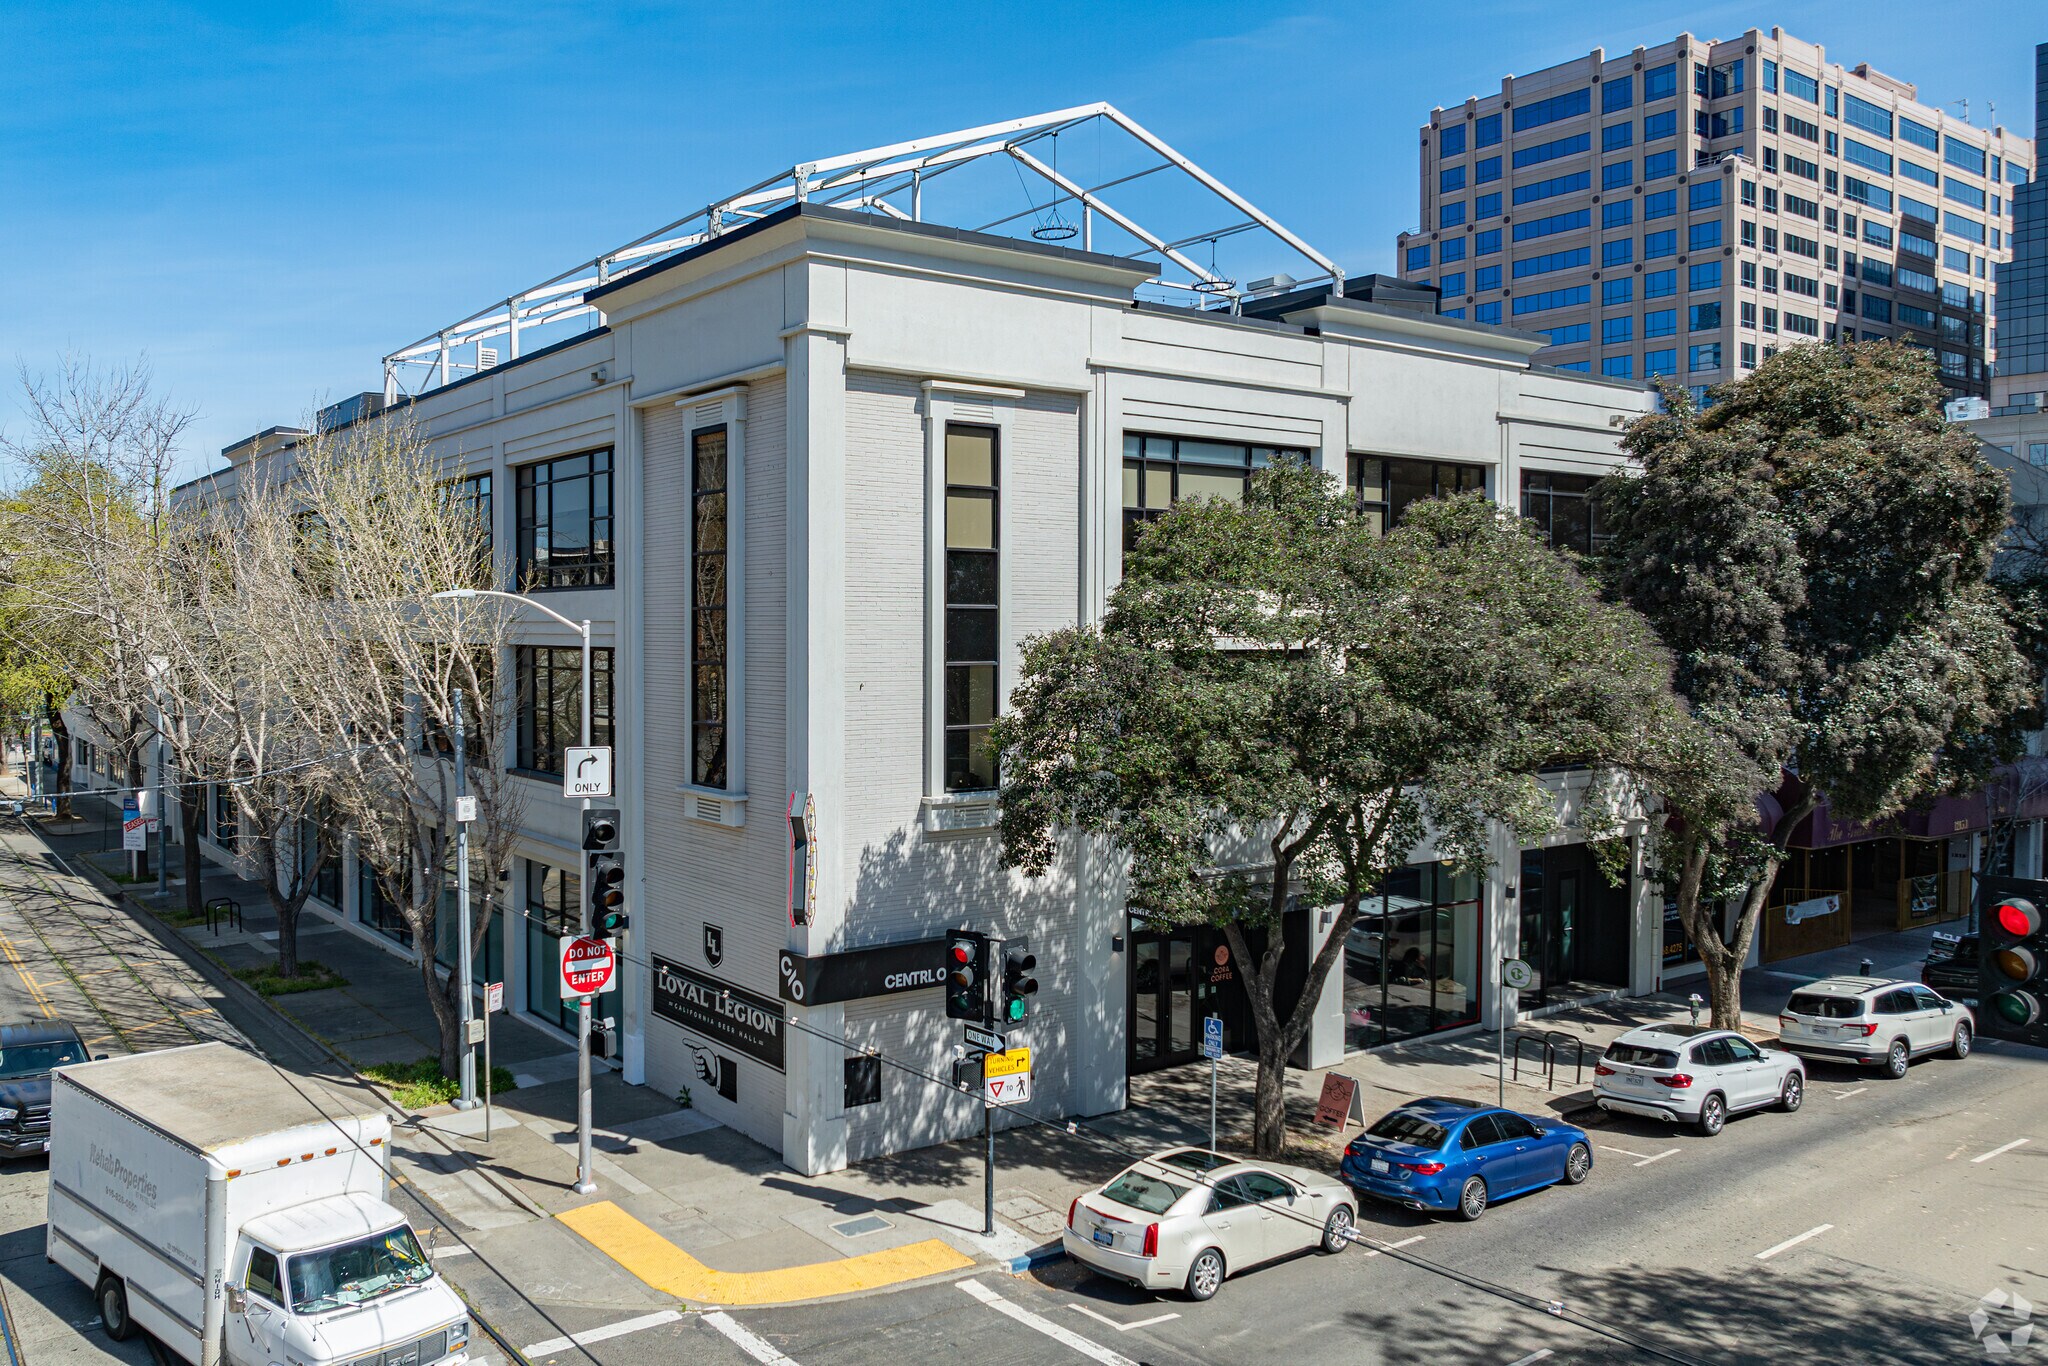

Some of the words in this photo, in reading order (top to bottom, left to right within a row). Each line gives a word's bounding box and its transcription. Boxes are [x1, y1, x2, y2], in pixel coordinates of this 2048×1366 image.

[575, 782, 601, 793] ONLY
[126, 818, 145, 831] LEASED
[707, 931, 720, 956] LL
[569, 948, 584, 959] DO
[587, 945, 606, 957] NOT
[1213, 966, 1230, 975] CORA
[571, 971, 604, 985] ENTER
[885, 969, 935, 989] CENTRL
[1210, 972, 1233, 983] COFFEE
[658, 968, 709, 1008] LOYAL
[715, 990, 776, 1036] LEGION
[673, 1004, 715, 1025] CALIFORNIA
[717, 1021, 735, 1034] BEER
[738, 1030, 757, 1044] HALL
[967, 1030, 980, 1042] ONE
[981, 1035, 995, 1047] WAY
[989, 1056, 1014, 1065] TURNING
[989, 1065, 1015, 1074] VEHICLES
[1319, 1105, 1346, 1118] COFFEE
